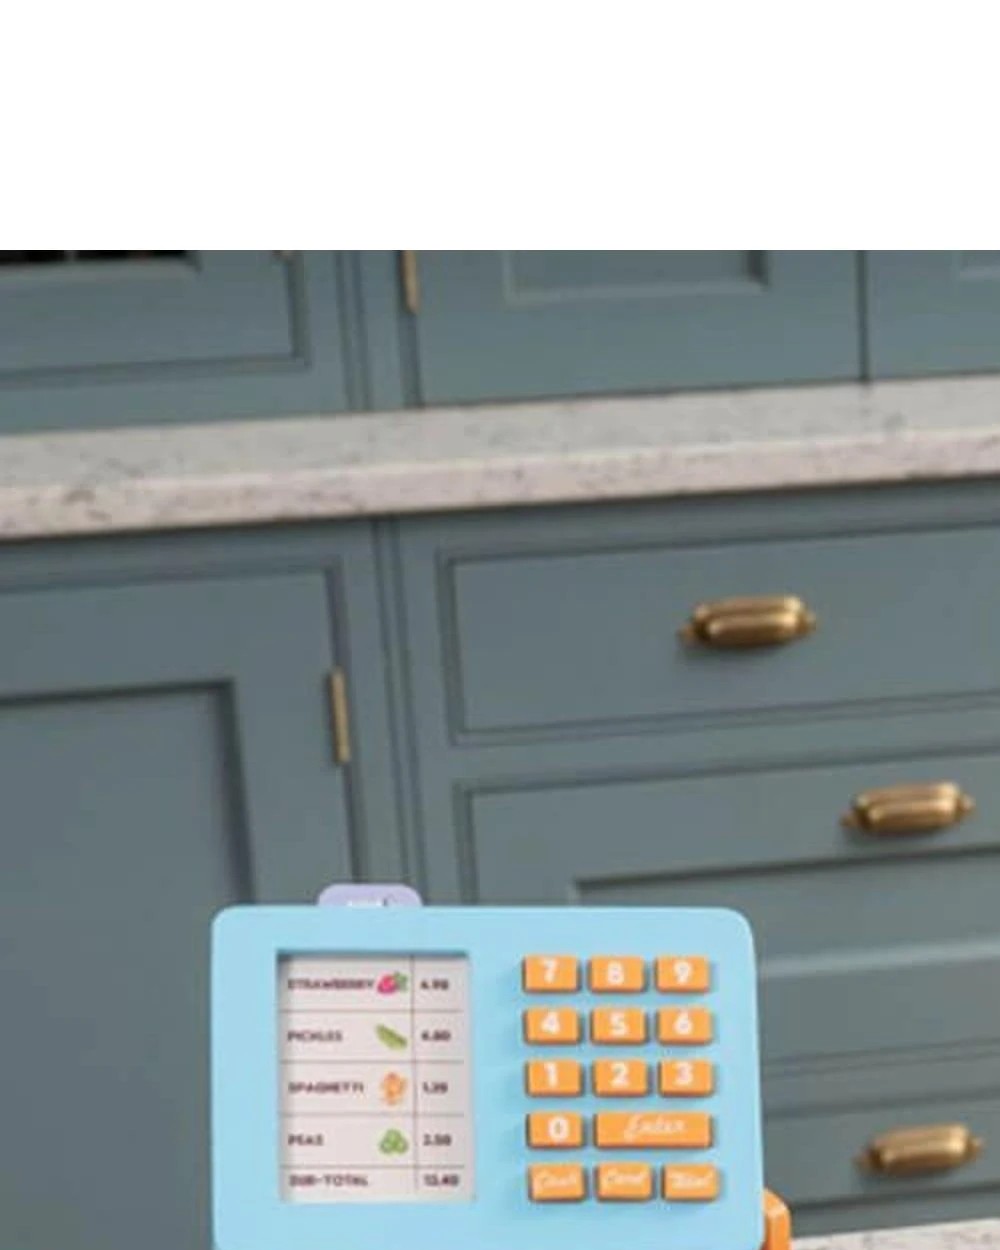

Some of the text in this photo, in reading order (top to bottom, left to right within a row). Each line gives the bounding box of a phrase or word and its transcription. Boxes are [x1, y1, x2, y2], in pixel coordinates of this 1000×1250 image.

[542, 958, 693, 986] 7 8 9
[539, 1009, 693, 1037] 4 5 6
[542, 1061, 694, 1088] 1 2 3
[547, 1115, 569, 1144] 0
